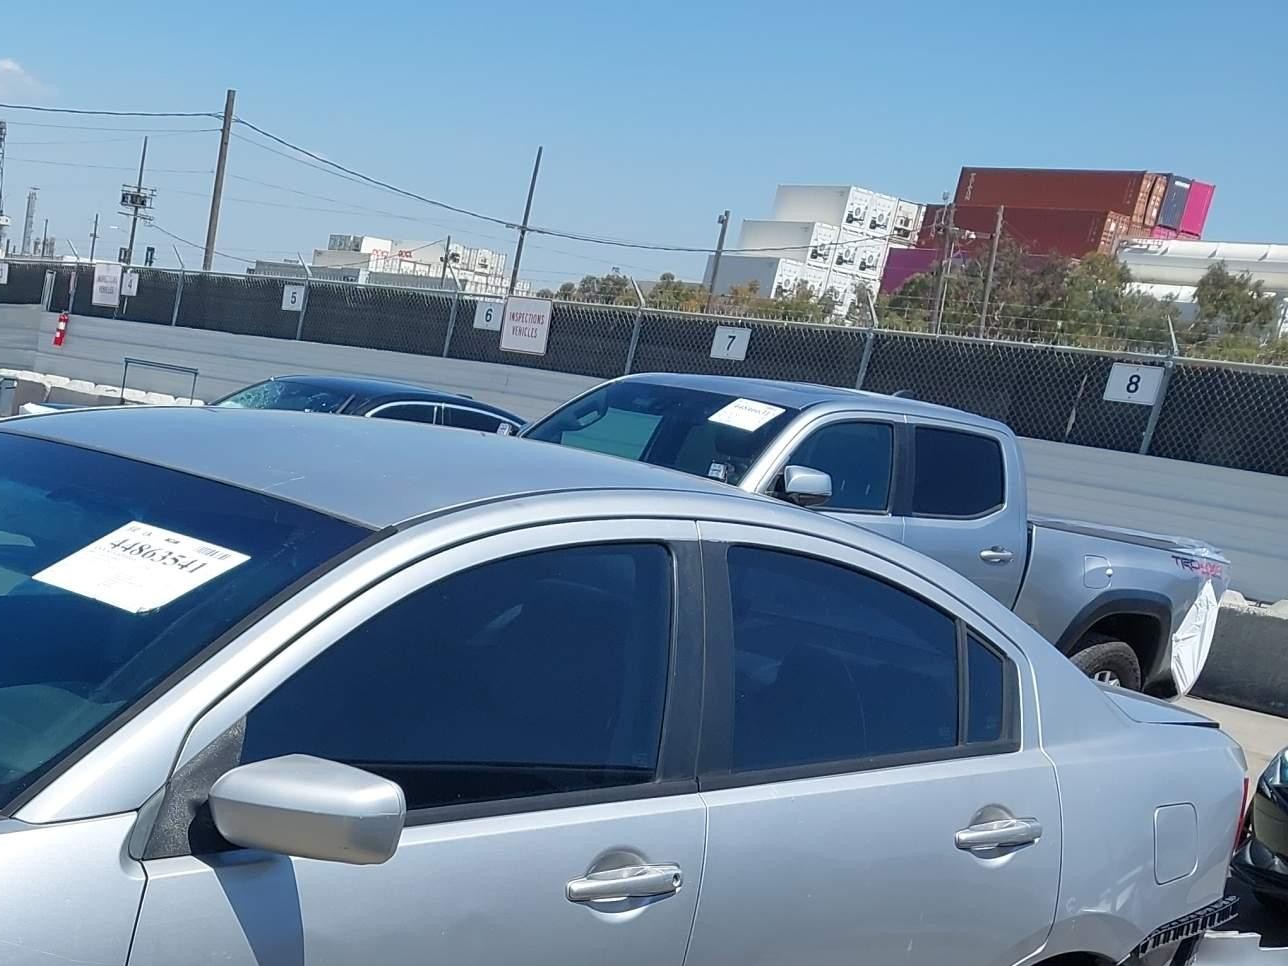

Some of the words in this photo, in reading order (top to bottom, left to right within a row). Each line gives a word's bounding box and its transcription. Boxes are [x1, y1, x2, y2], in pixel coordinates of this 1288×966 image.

[291, 291, 297, 305] 5
[485, 308, 494, 322] 6
[509, 311, 545, 325] INSPECTIONS
[512, 326, 538, 338] VEHICLES
[727, 335, 737, 351] 7
[1126, 374, 1141, 393] 8
[110, 538, 209, 573] 44863541
